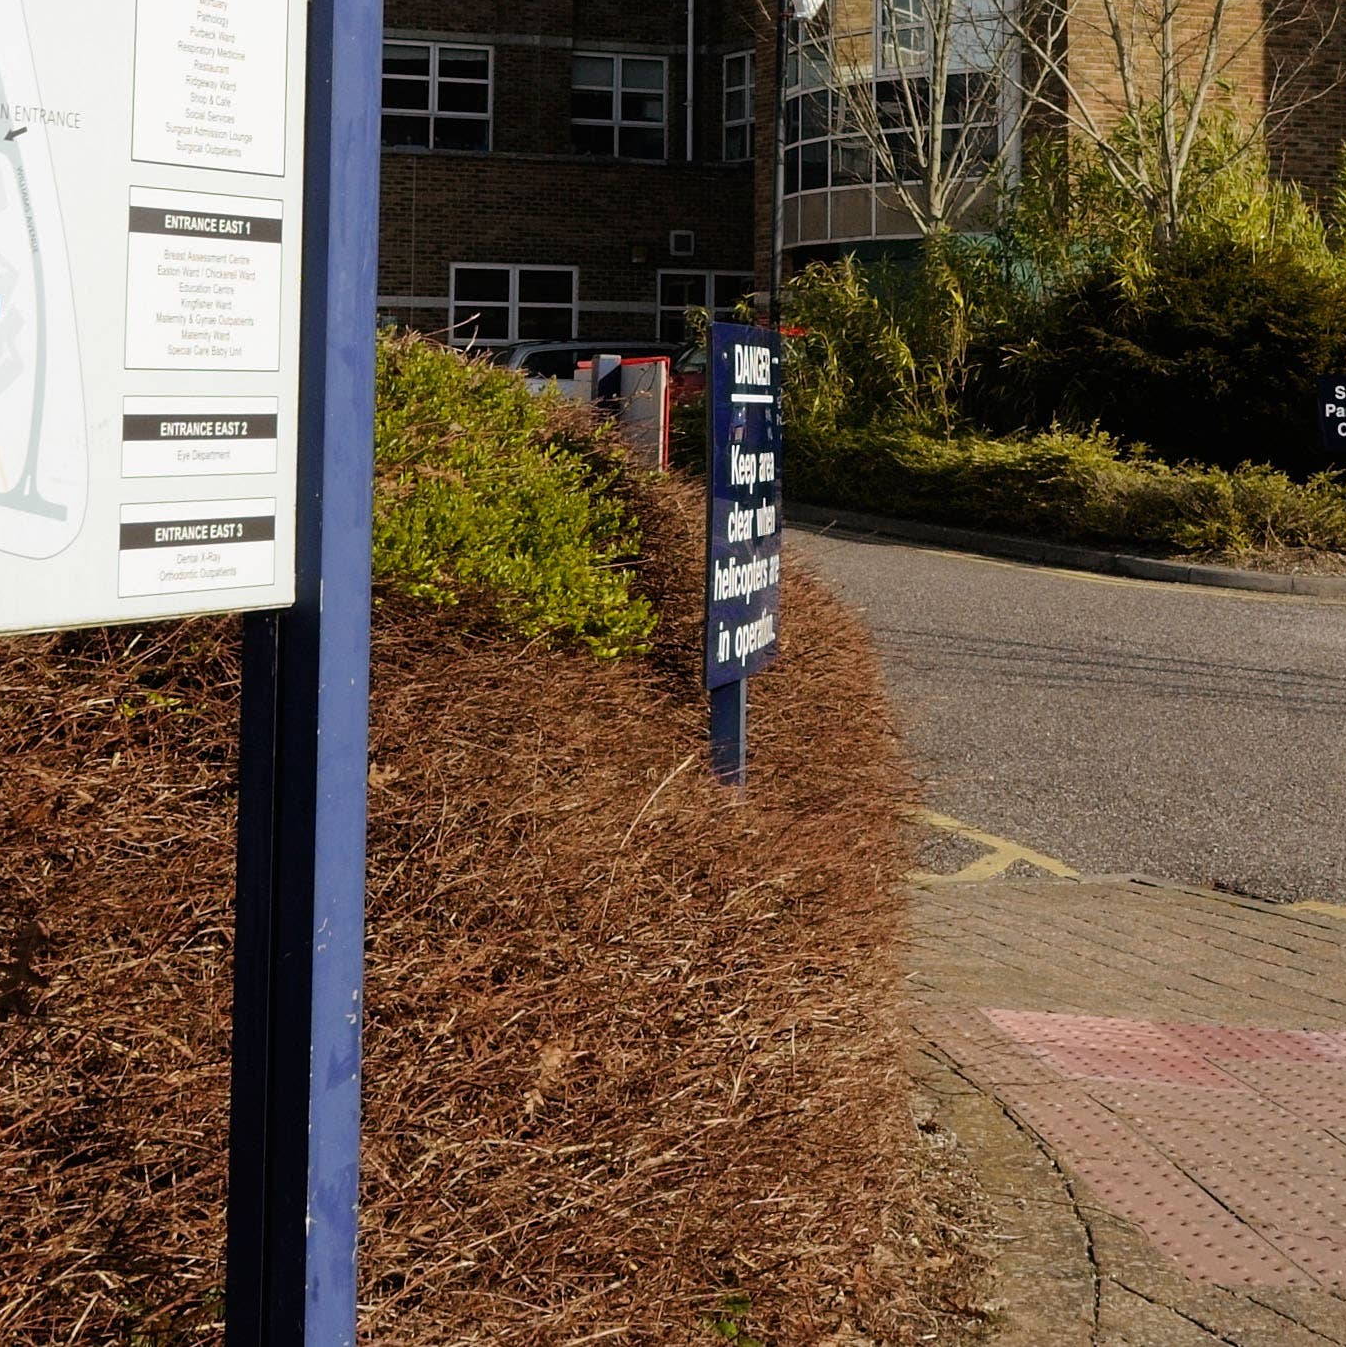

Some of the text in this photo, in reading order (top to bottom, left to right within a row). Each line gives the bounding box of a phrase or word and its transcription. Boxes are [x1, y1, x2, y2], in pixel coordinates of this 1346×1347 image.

[15, 105, 82, 129] ENTRANCE
[164, 214, 250, 234] ENTRANCE EAST 1
[734, 344, 771, 386] DANGER
[160, 421, 247, 436] ENTRANCE EAST 2
[731, 444, 775, 495] Keep area
[154, 523, 242, 541] ENTRANCE EAST 3
[727, 497, 776, 543] clear when
[714, 554, 780, 605] helicopters are
[718, 608, 776, 667] in operation.
